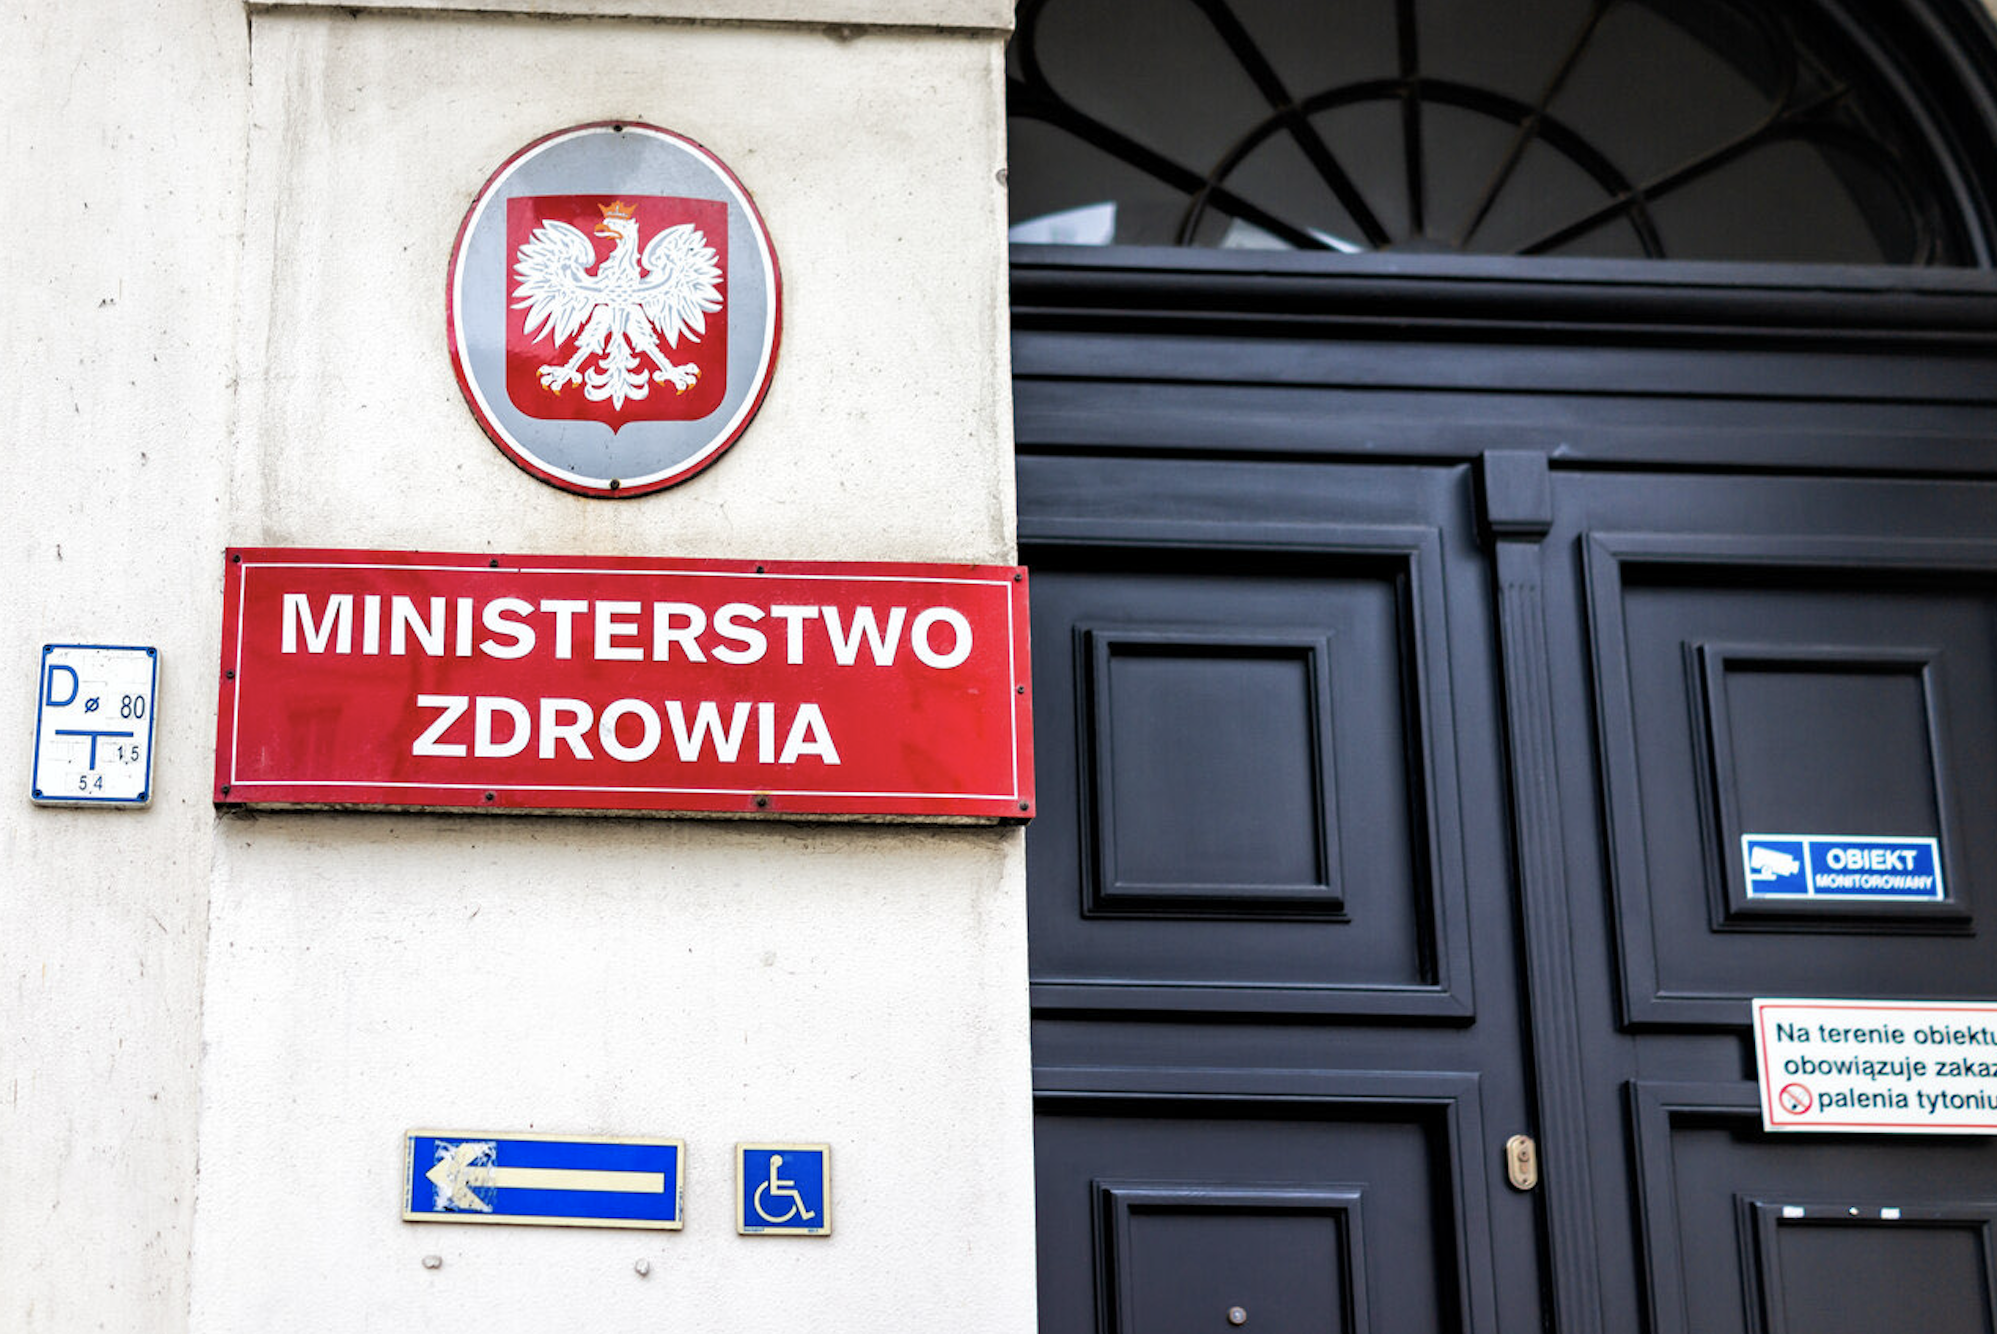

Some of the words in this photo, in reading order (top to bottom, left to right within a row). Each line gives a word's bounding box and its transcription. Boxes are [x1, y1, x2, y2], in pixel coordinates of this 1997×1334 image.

[281, 593, 974, 670] MINISTERSTWO
[46, 664, 79, 707] D
[120, 694, 146, 719] 80
[412, 694, 841, 765] ZDROWIA
[1826, 848, 1918, 871] OBIEKT
[1814, 873, 1934, 890] MONITOROWANY
[1776, 1022, 1810, 1043] Na
[1818, 1023, 1905, 1044] terenie
[1783, 1055, 1927, 1082] obowiązuje
[1818, 1088, 1909, 1112] palenia
[1916, 1089, 1997, 1115] tytoniu
